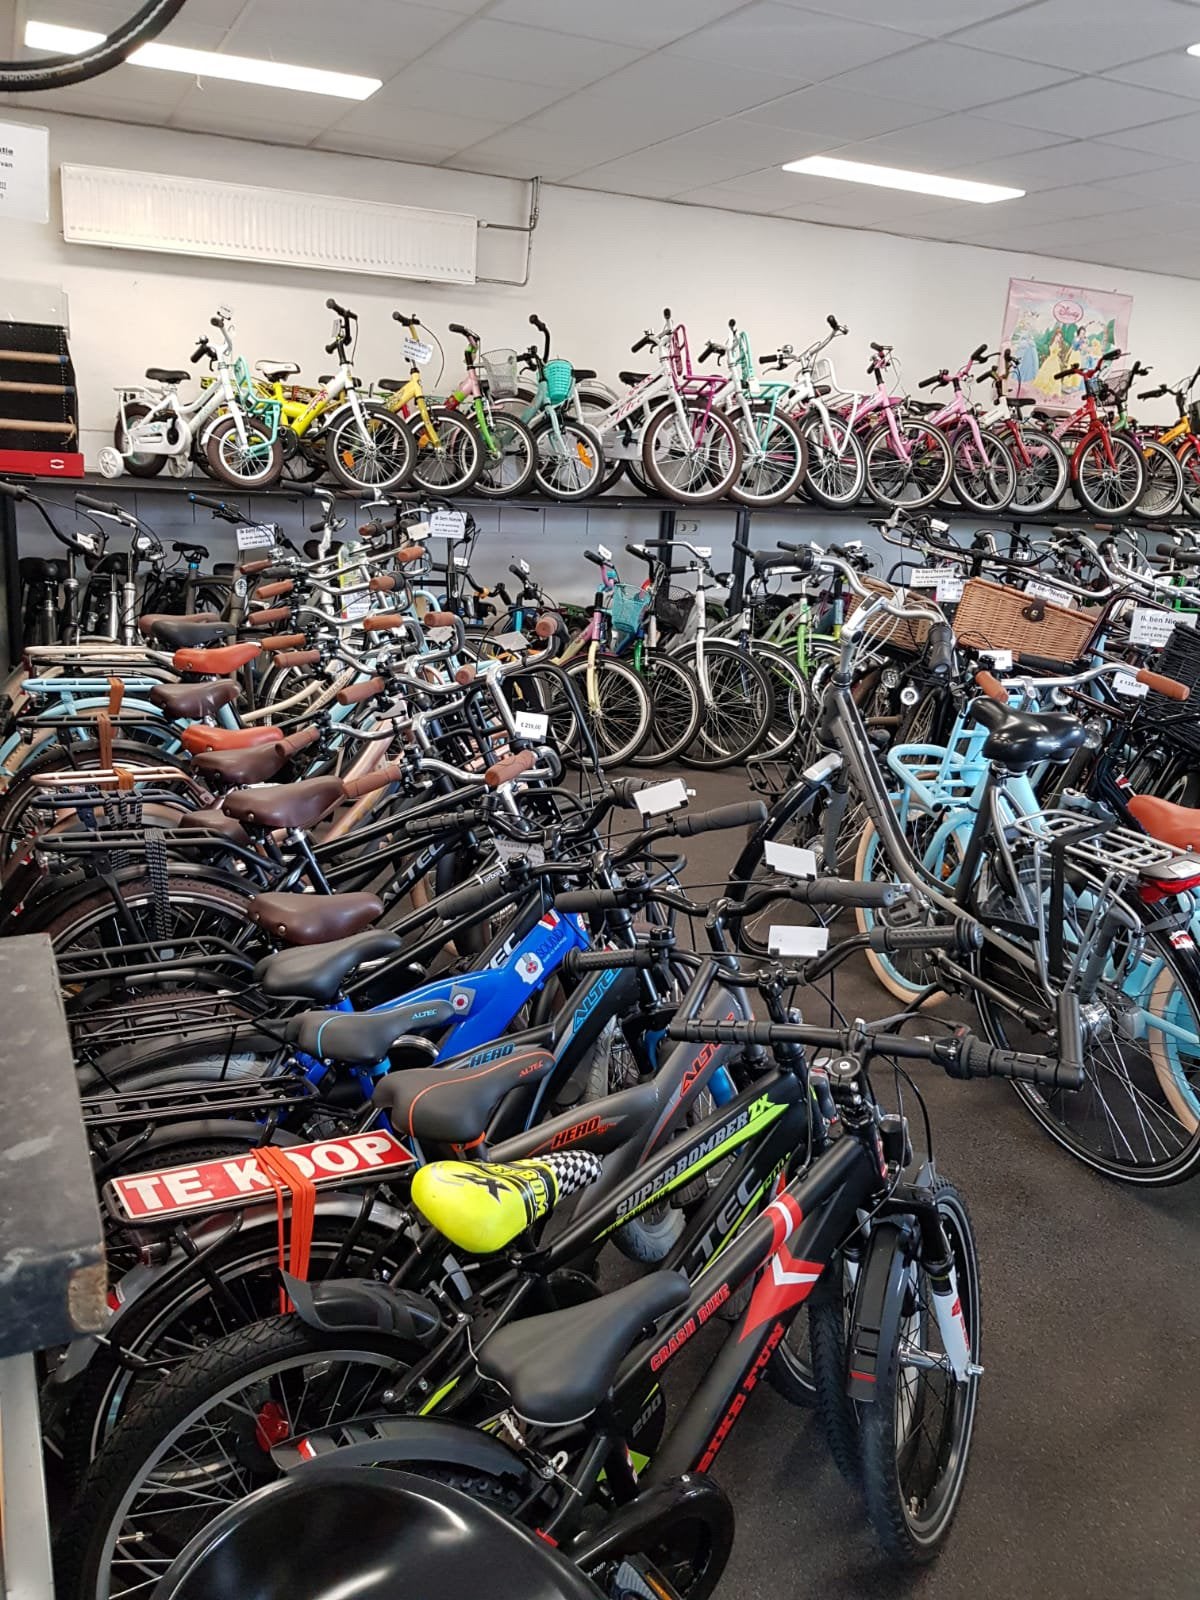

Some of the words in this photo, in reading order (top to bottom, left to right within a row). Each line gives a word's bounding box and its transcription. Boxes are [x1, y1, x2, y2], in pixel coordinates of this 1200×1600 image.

[1149, 616, 1163, 624] ben
[411, 1008, 438, 1020] ALTEC
[123, 1169, 214, 1210] TE
[222, 1135, 393, 1192] KOOP
[616, 1110, 749, 1217] SUPERBOMBER
[748, 1093, 776, 1122] ZX
[650, 1317, 697, 1372] CRASH
[697, 1282, 731, 1325] BIKE
[696, 1393, 747, 1473] BIKE
[743, 1321, 785, 1392] FUN
